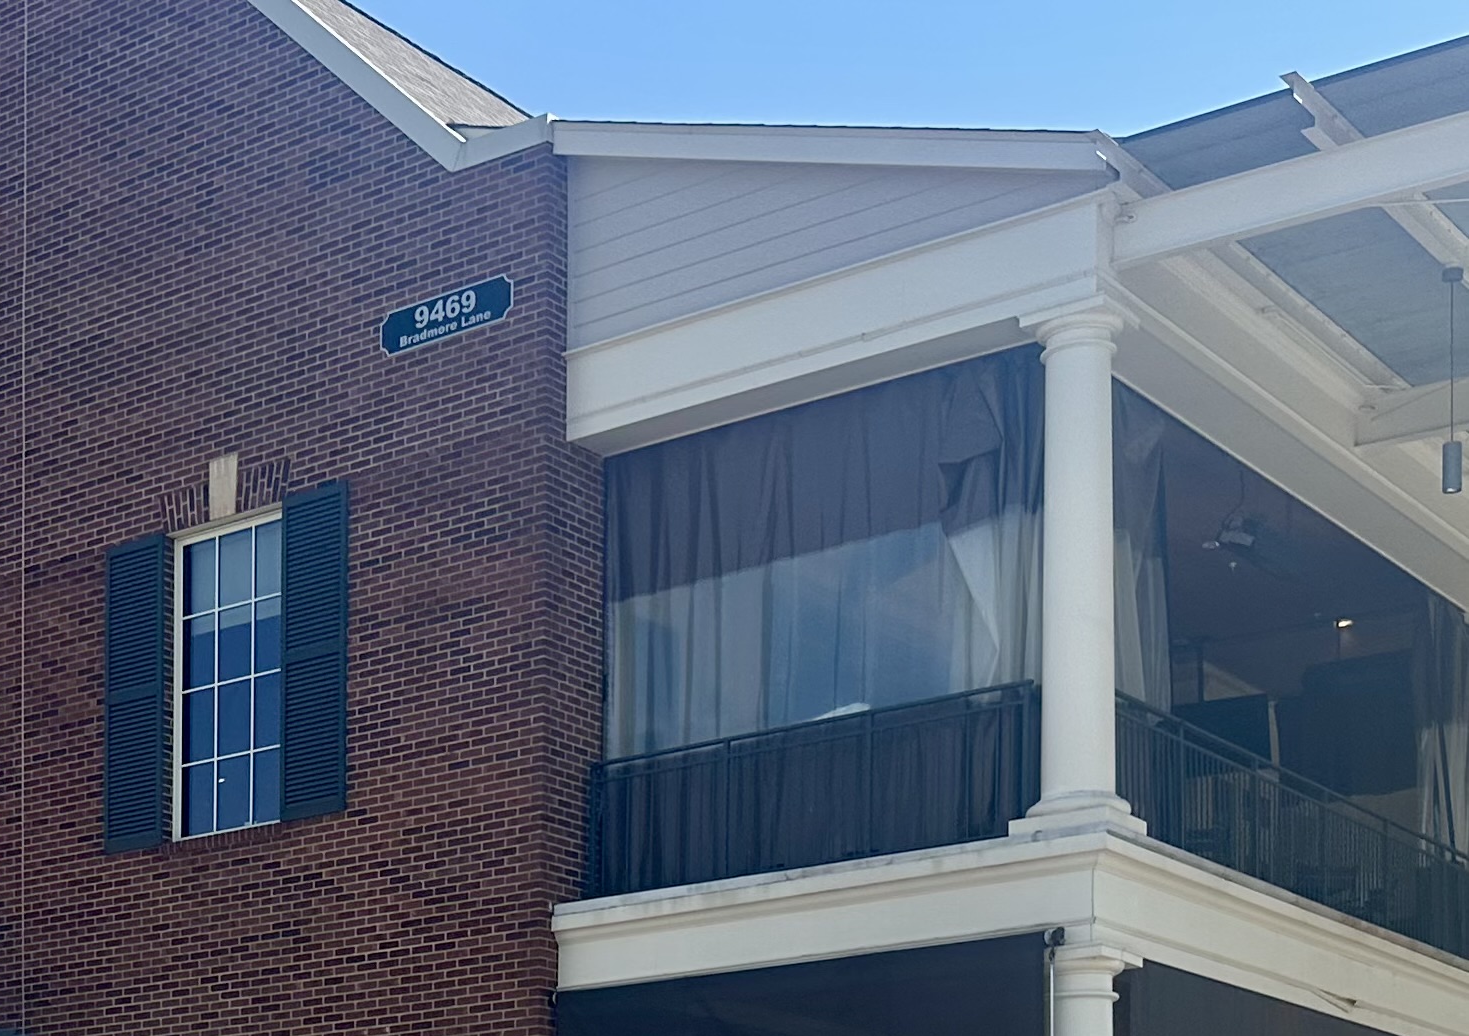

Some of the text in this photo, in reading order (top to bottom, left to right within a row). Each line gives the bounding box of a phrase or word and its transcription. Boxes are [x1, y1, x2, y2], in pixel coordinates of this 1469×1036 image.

[414, 290, 476, 329] 9469
[399, 311, 491, 348] Bradmore Lane
